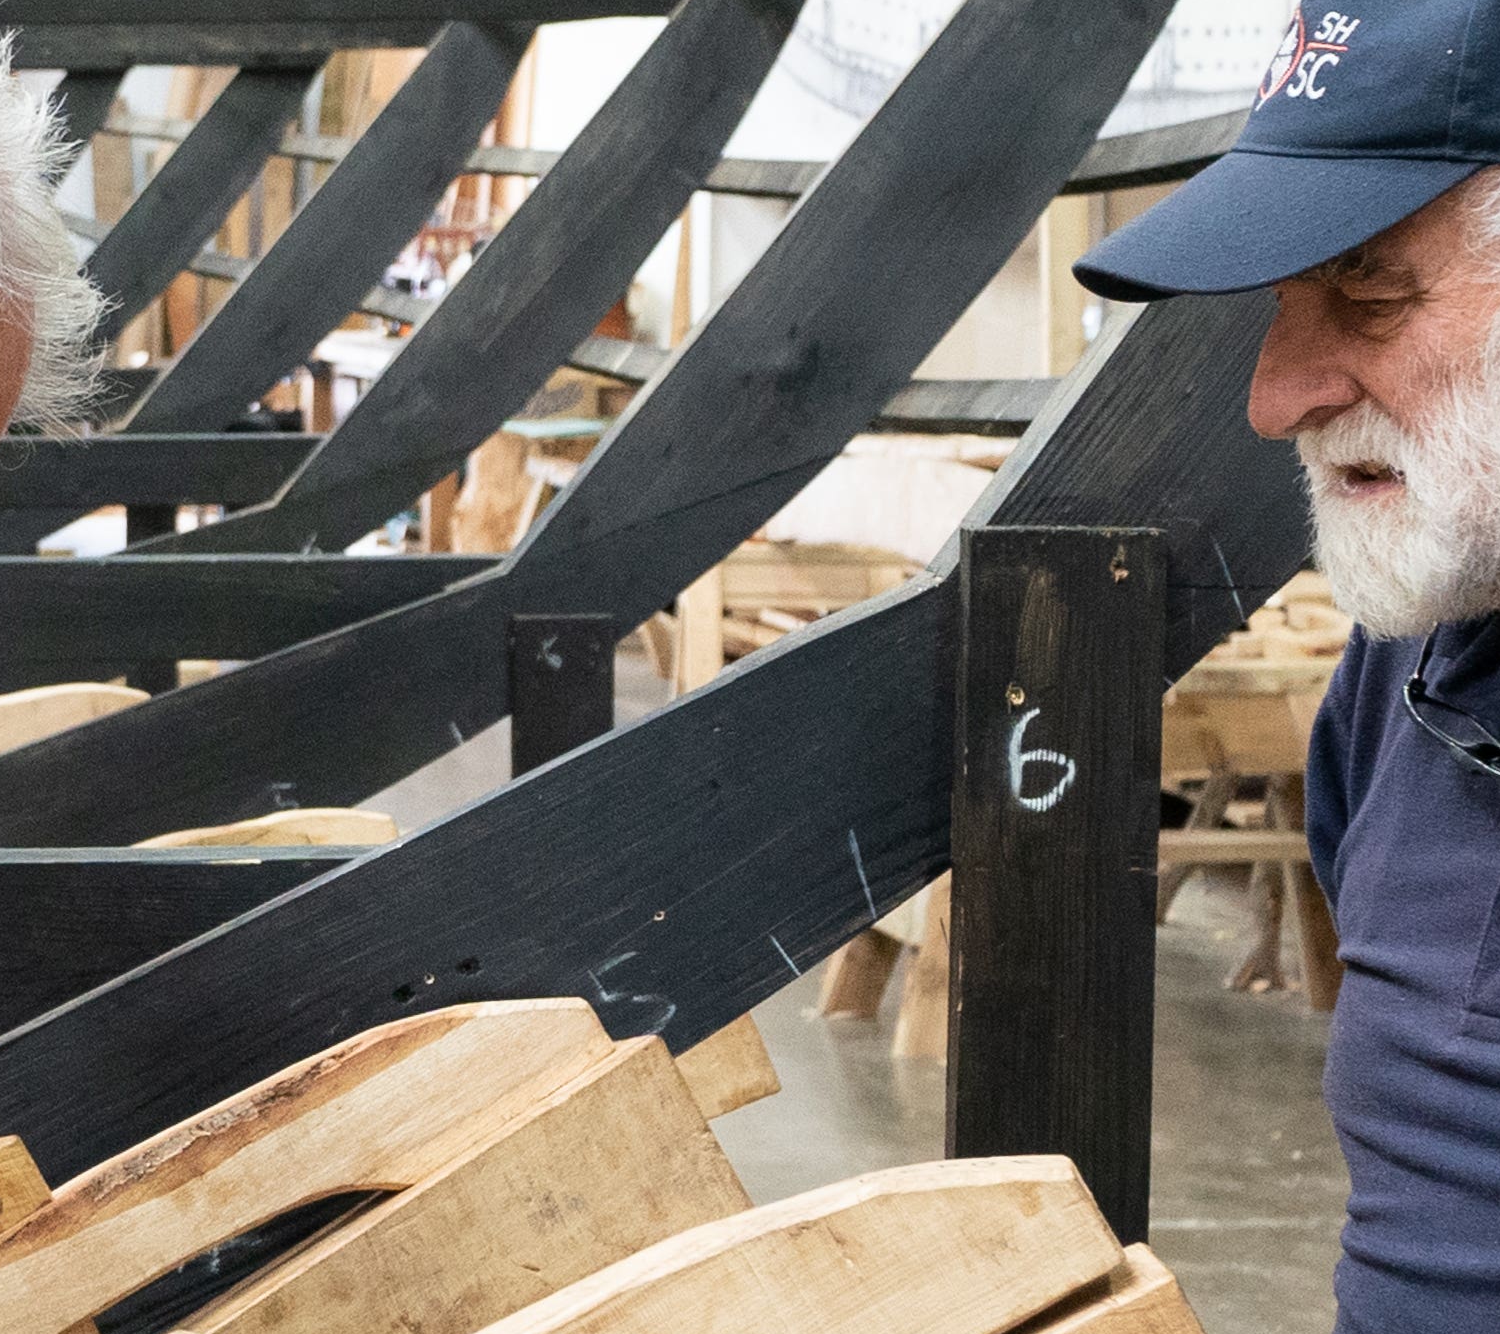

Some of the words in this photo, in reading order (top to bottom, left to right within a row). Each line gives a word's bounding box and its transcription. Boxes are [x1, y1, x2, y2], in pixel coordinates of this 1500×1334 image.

[1314, 11, 1361, 44] SH
[1286, 51, 1341, 100] SC
[1008, 707, 1076, 813] 6
